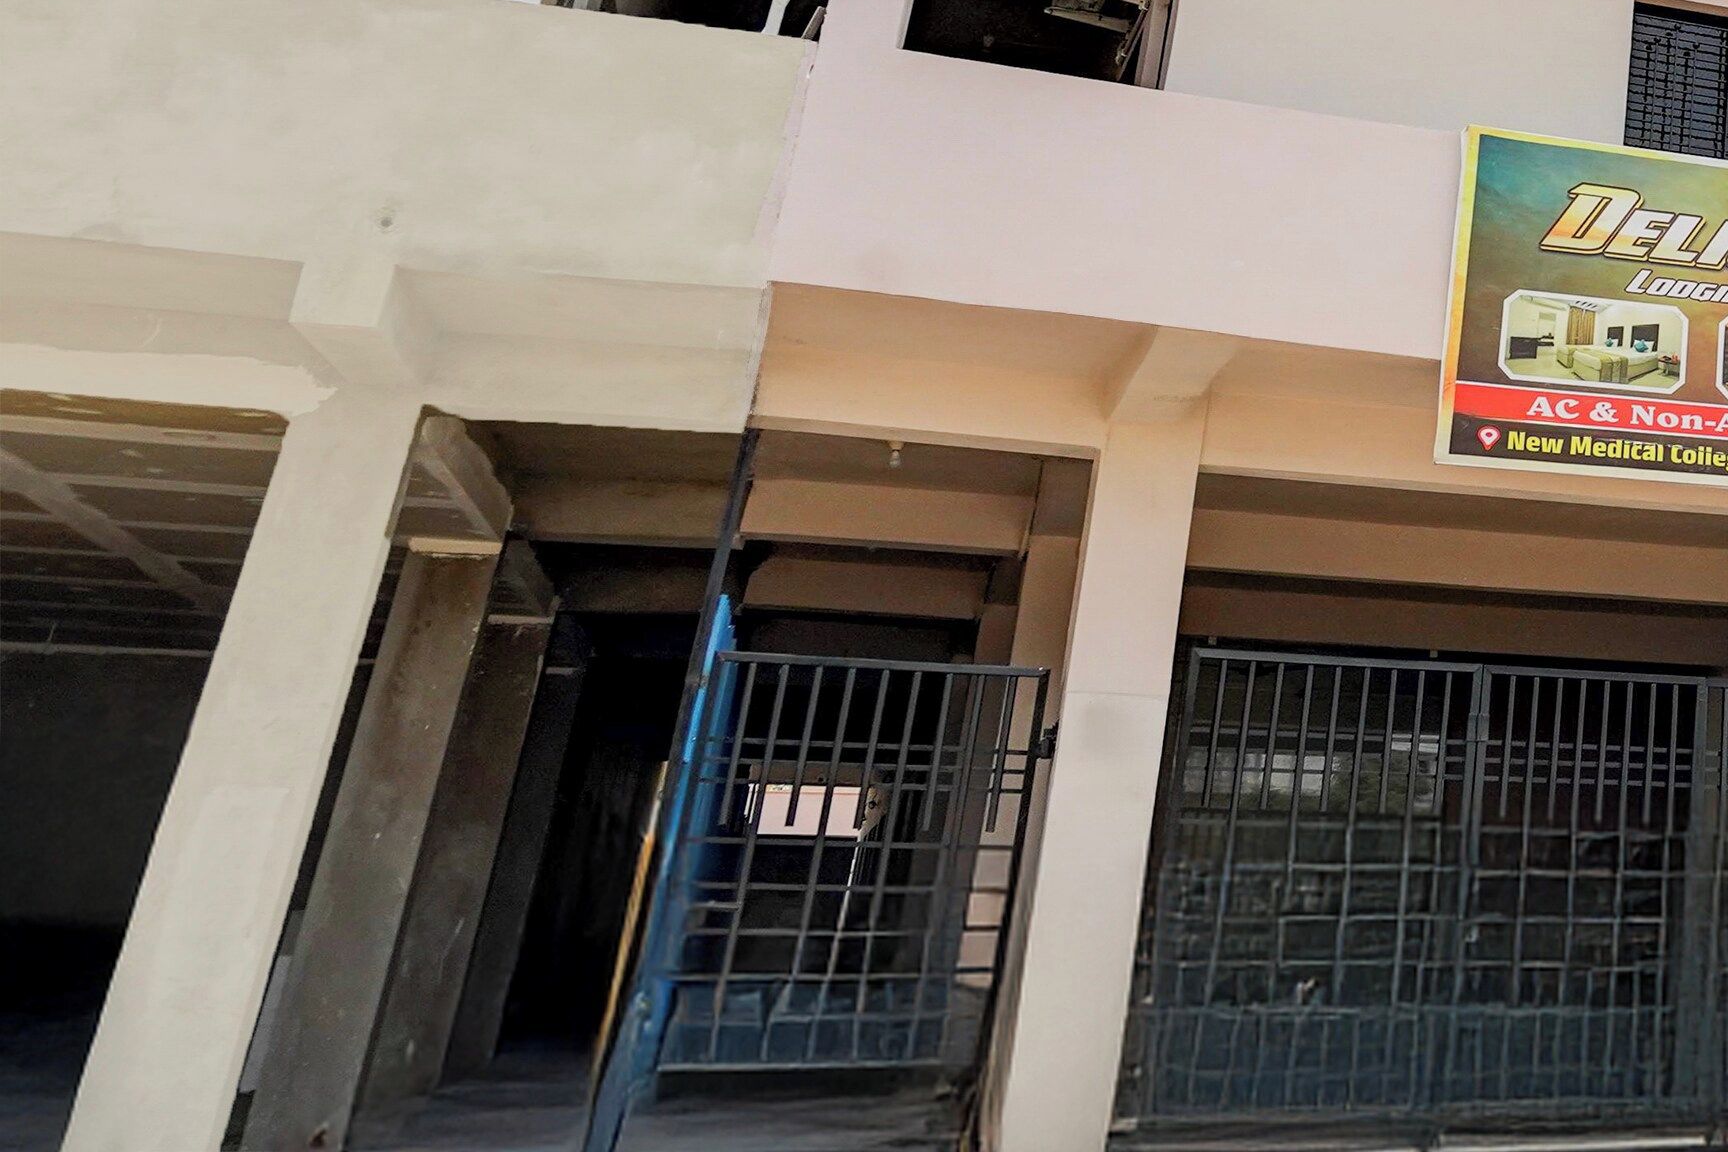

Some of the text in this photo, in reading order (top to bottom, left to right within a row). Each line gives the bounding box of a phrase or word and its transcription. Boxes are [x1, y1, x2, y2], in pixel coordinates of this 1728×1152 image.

[1526, 395, 1580, 419] AC
[1589, 401, 1620, 423] &
[1506, 430, 1564, 455] New
[1569, 435, 1664, 463] Medical
